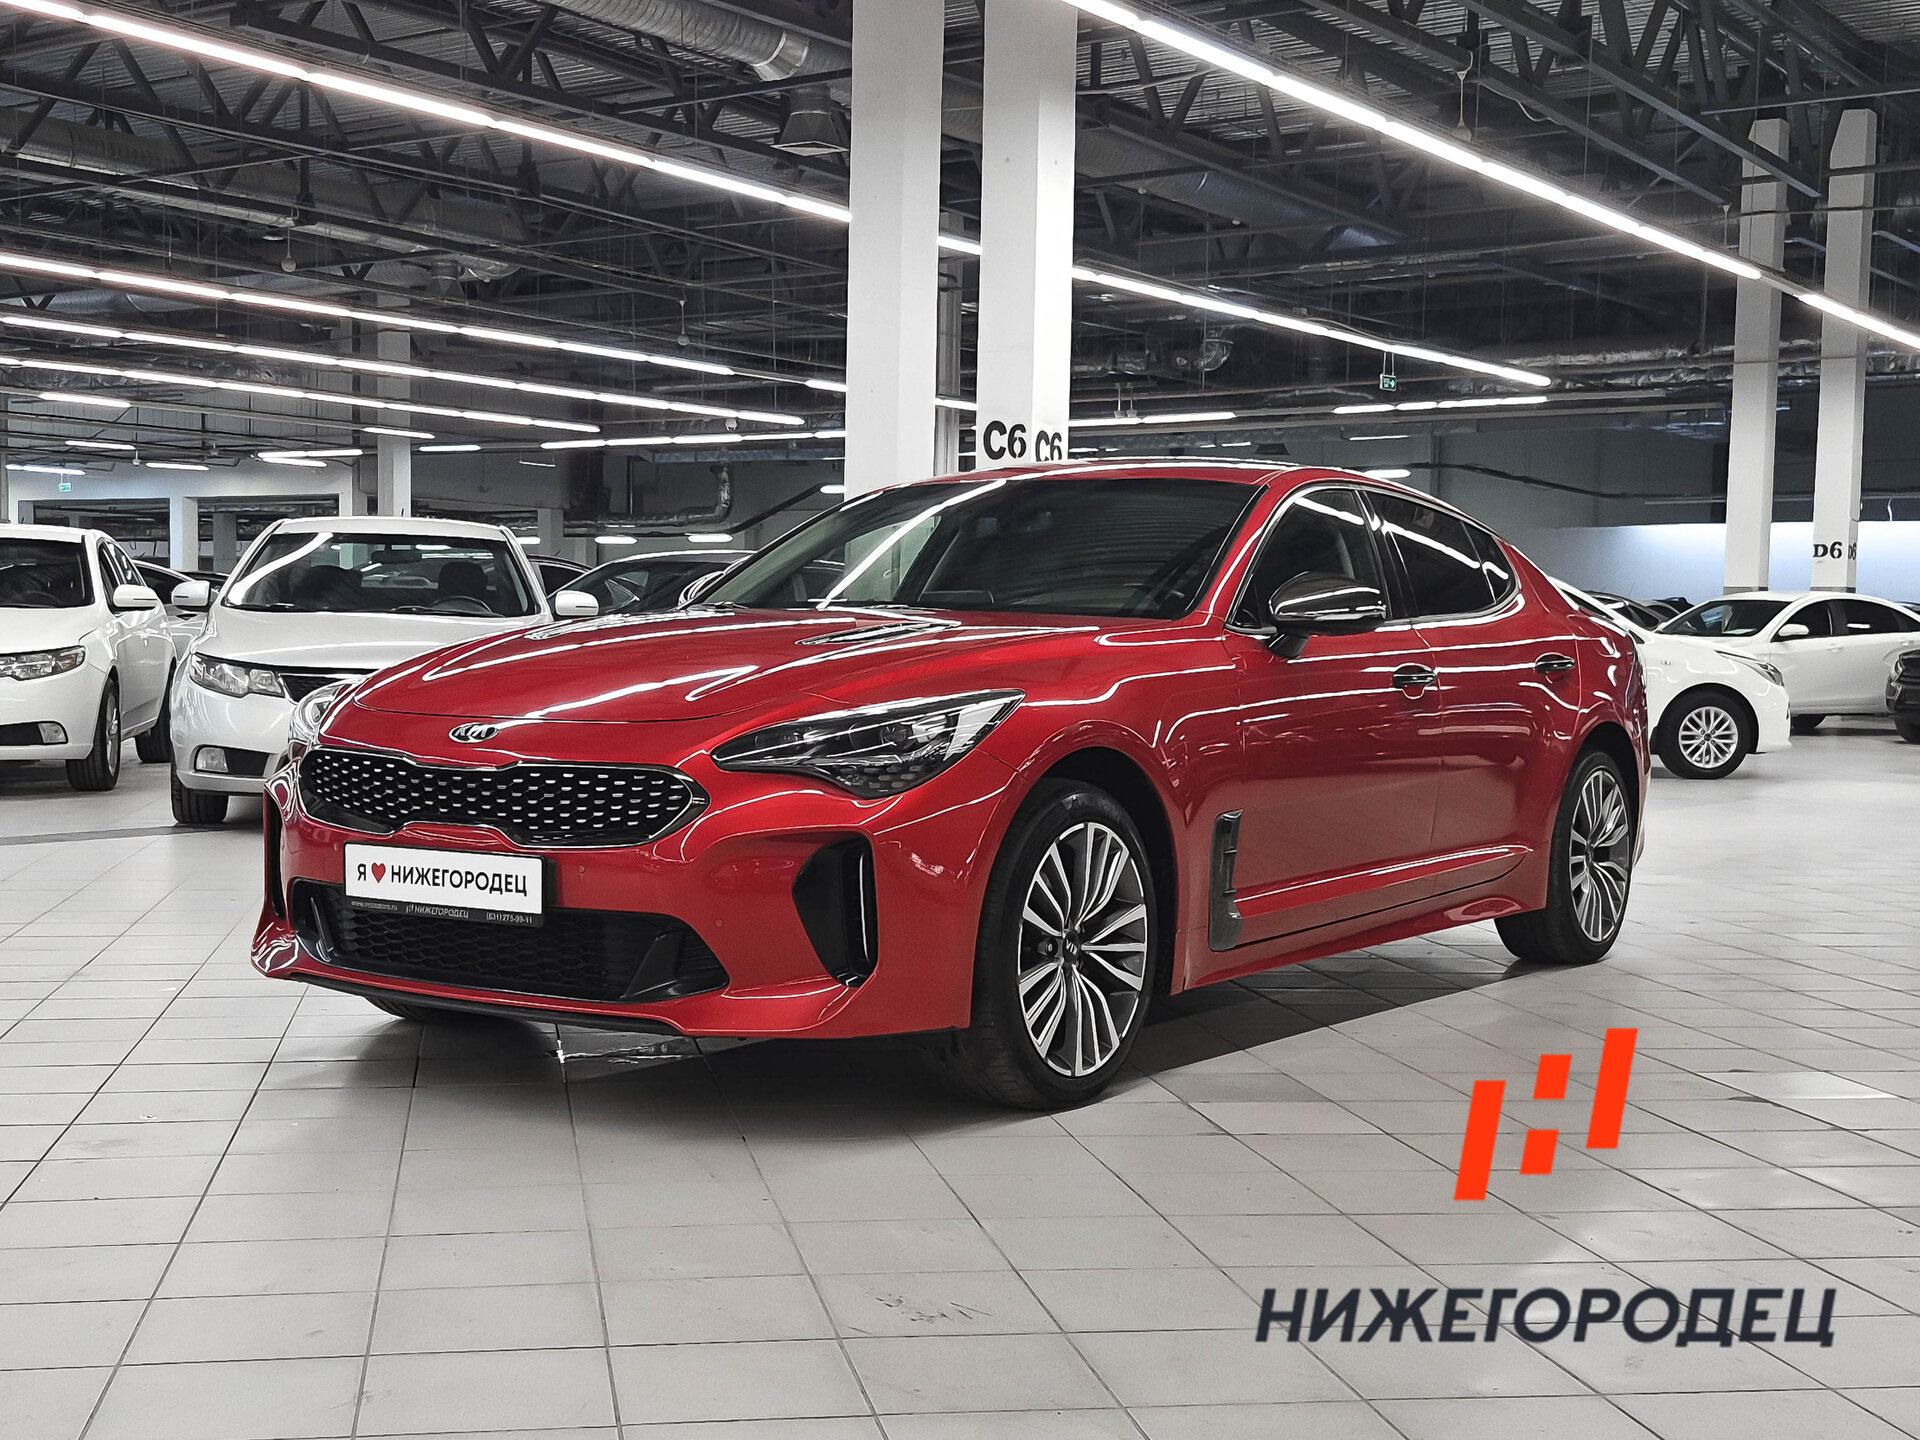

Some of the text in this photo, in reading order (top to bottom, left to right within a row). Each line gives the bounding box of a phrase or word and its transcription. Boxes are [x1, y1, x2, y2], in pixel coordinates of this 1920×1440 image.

[983, 420, 1027, 460] C6
[1035, 430, 1062, 462] C6
[1813, 541, 1842, 559] D6
[357, 863, 528, 897] Я НИЖЕГОРОДЕЦ
[414, 904, 469, 919] НИЖЕГОРОДЕЦ
